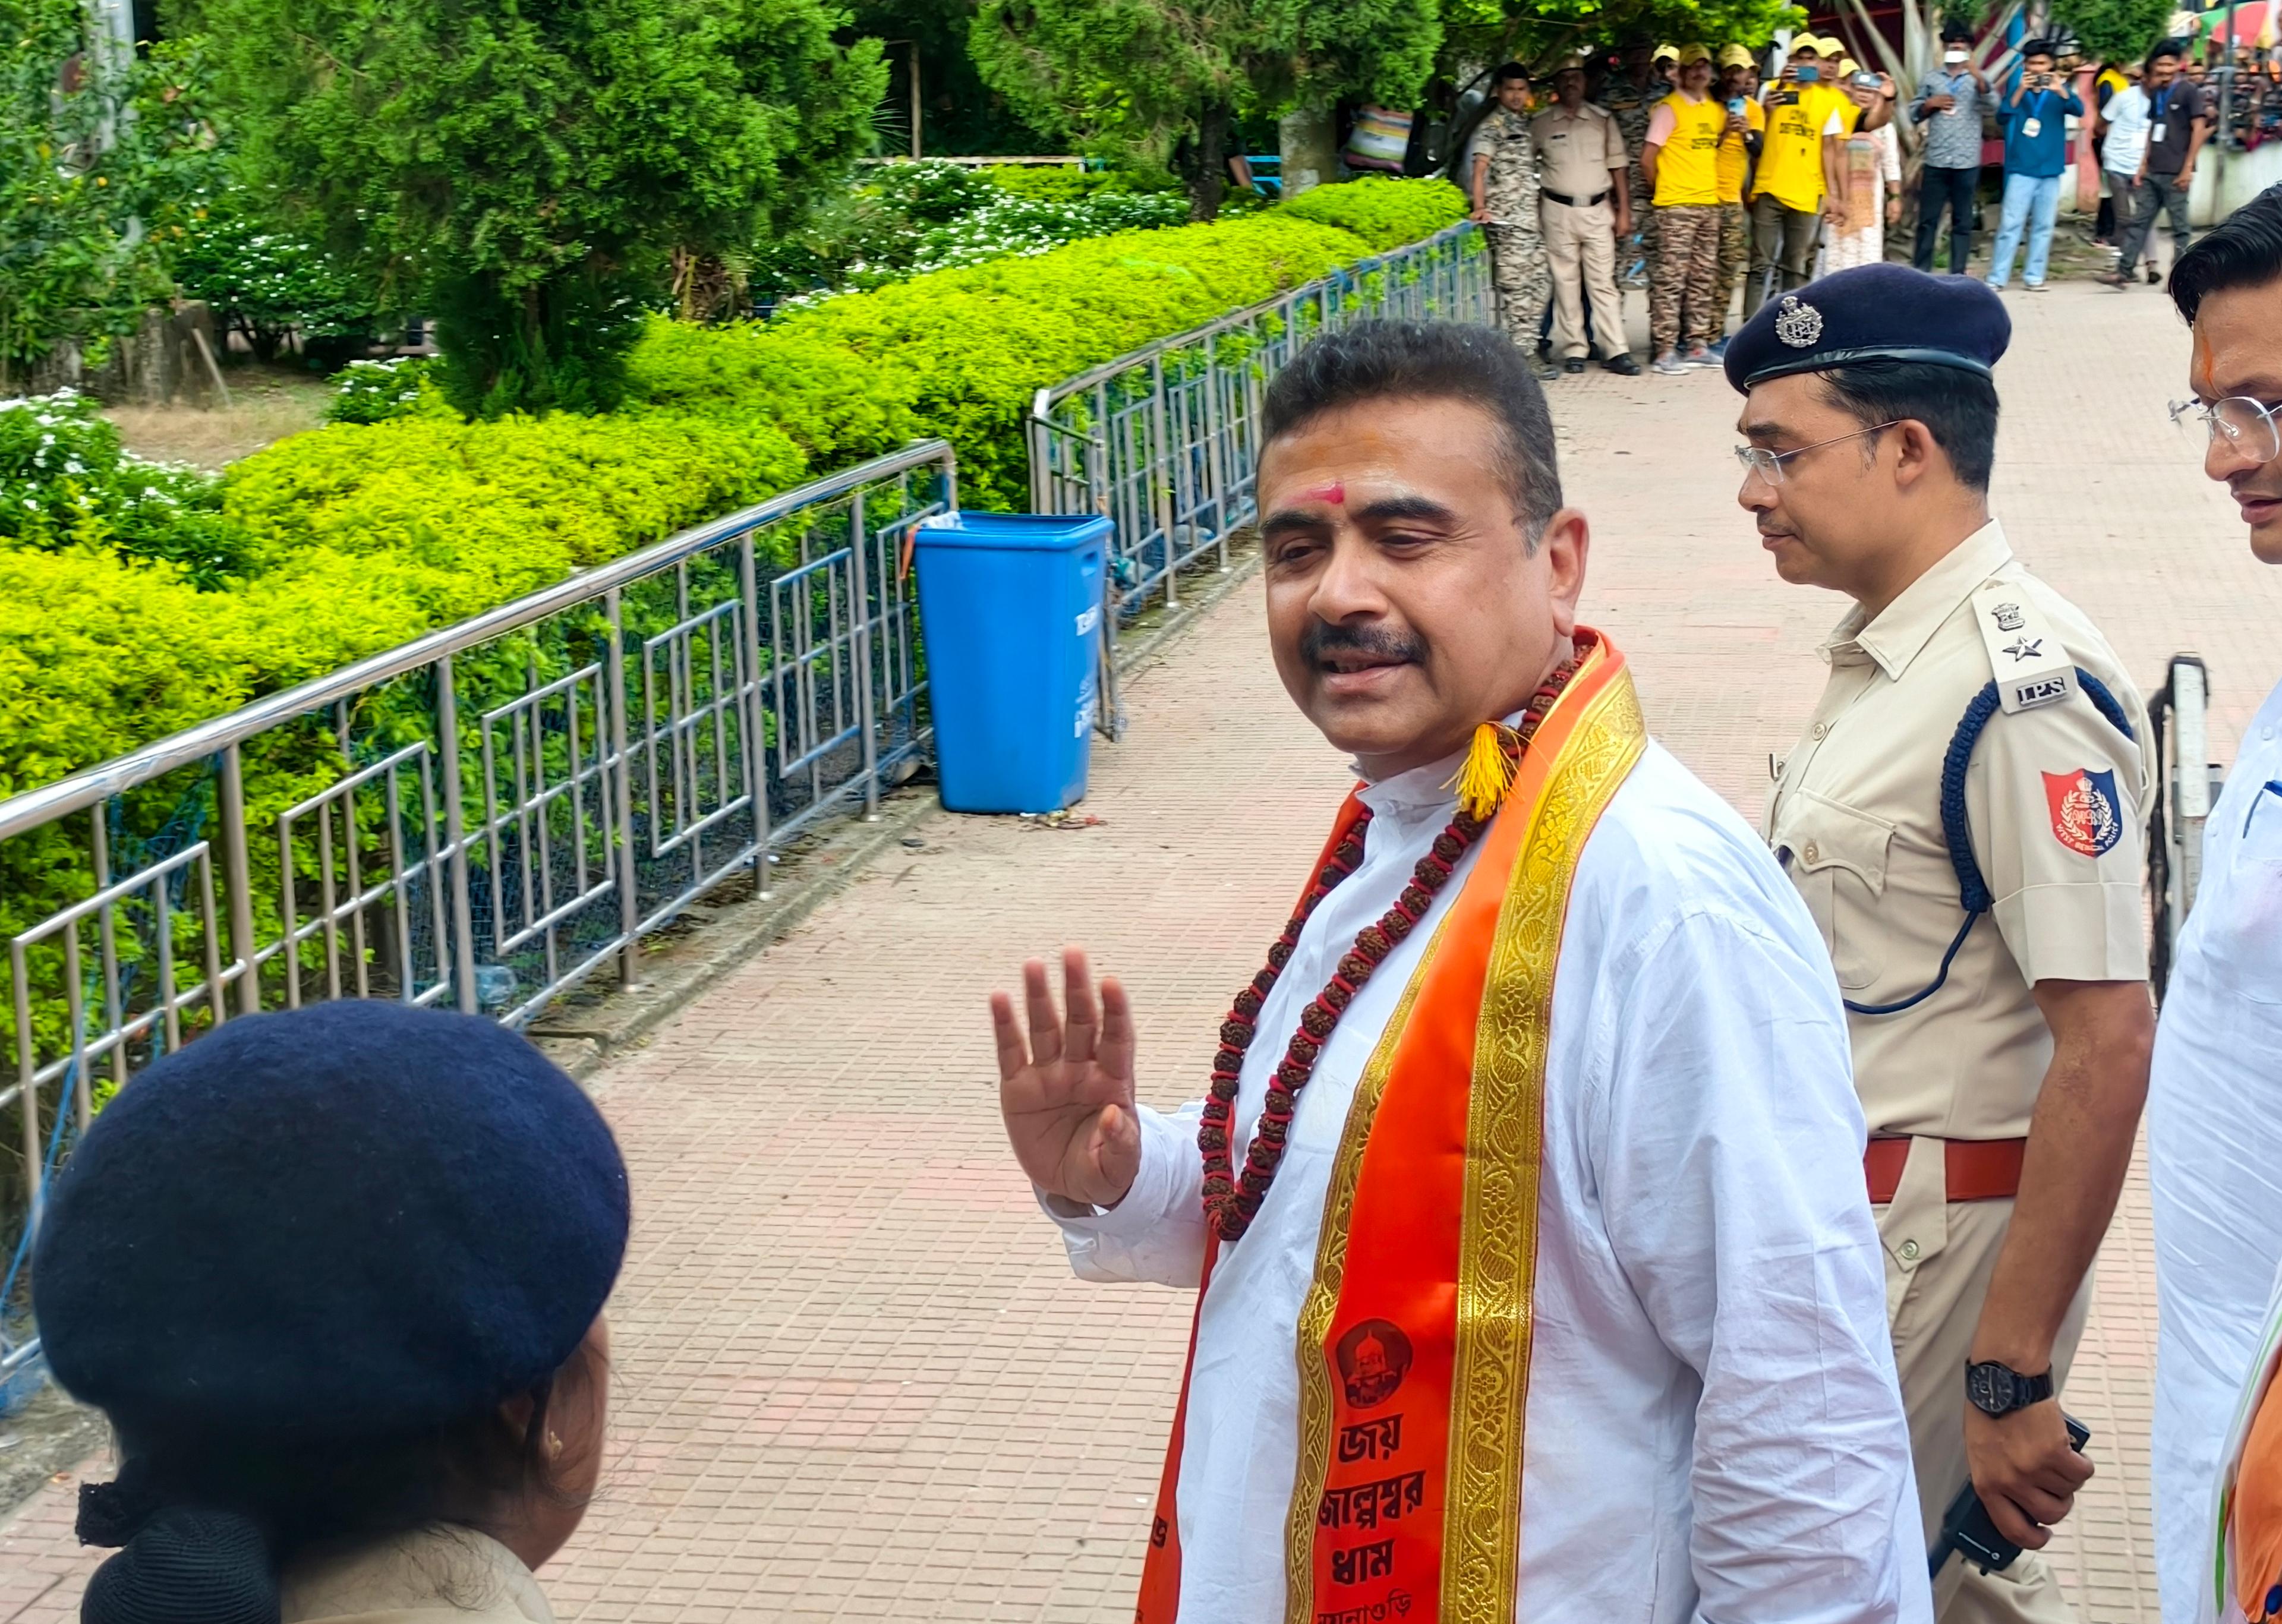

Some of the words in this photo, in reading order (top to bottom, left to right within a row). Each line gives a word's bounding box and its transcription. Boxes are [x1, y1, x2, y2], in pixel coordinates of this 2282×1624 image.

[2018, 678, 2066, 705] IPS
[1338, 1413, 1404, 1463] জয়
[1332, 1538, 1394, 1585] ধাম
